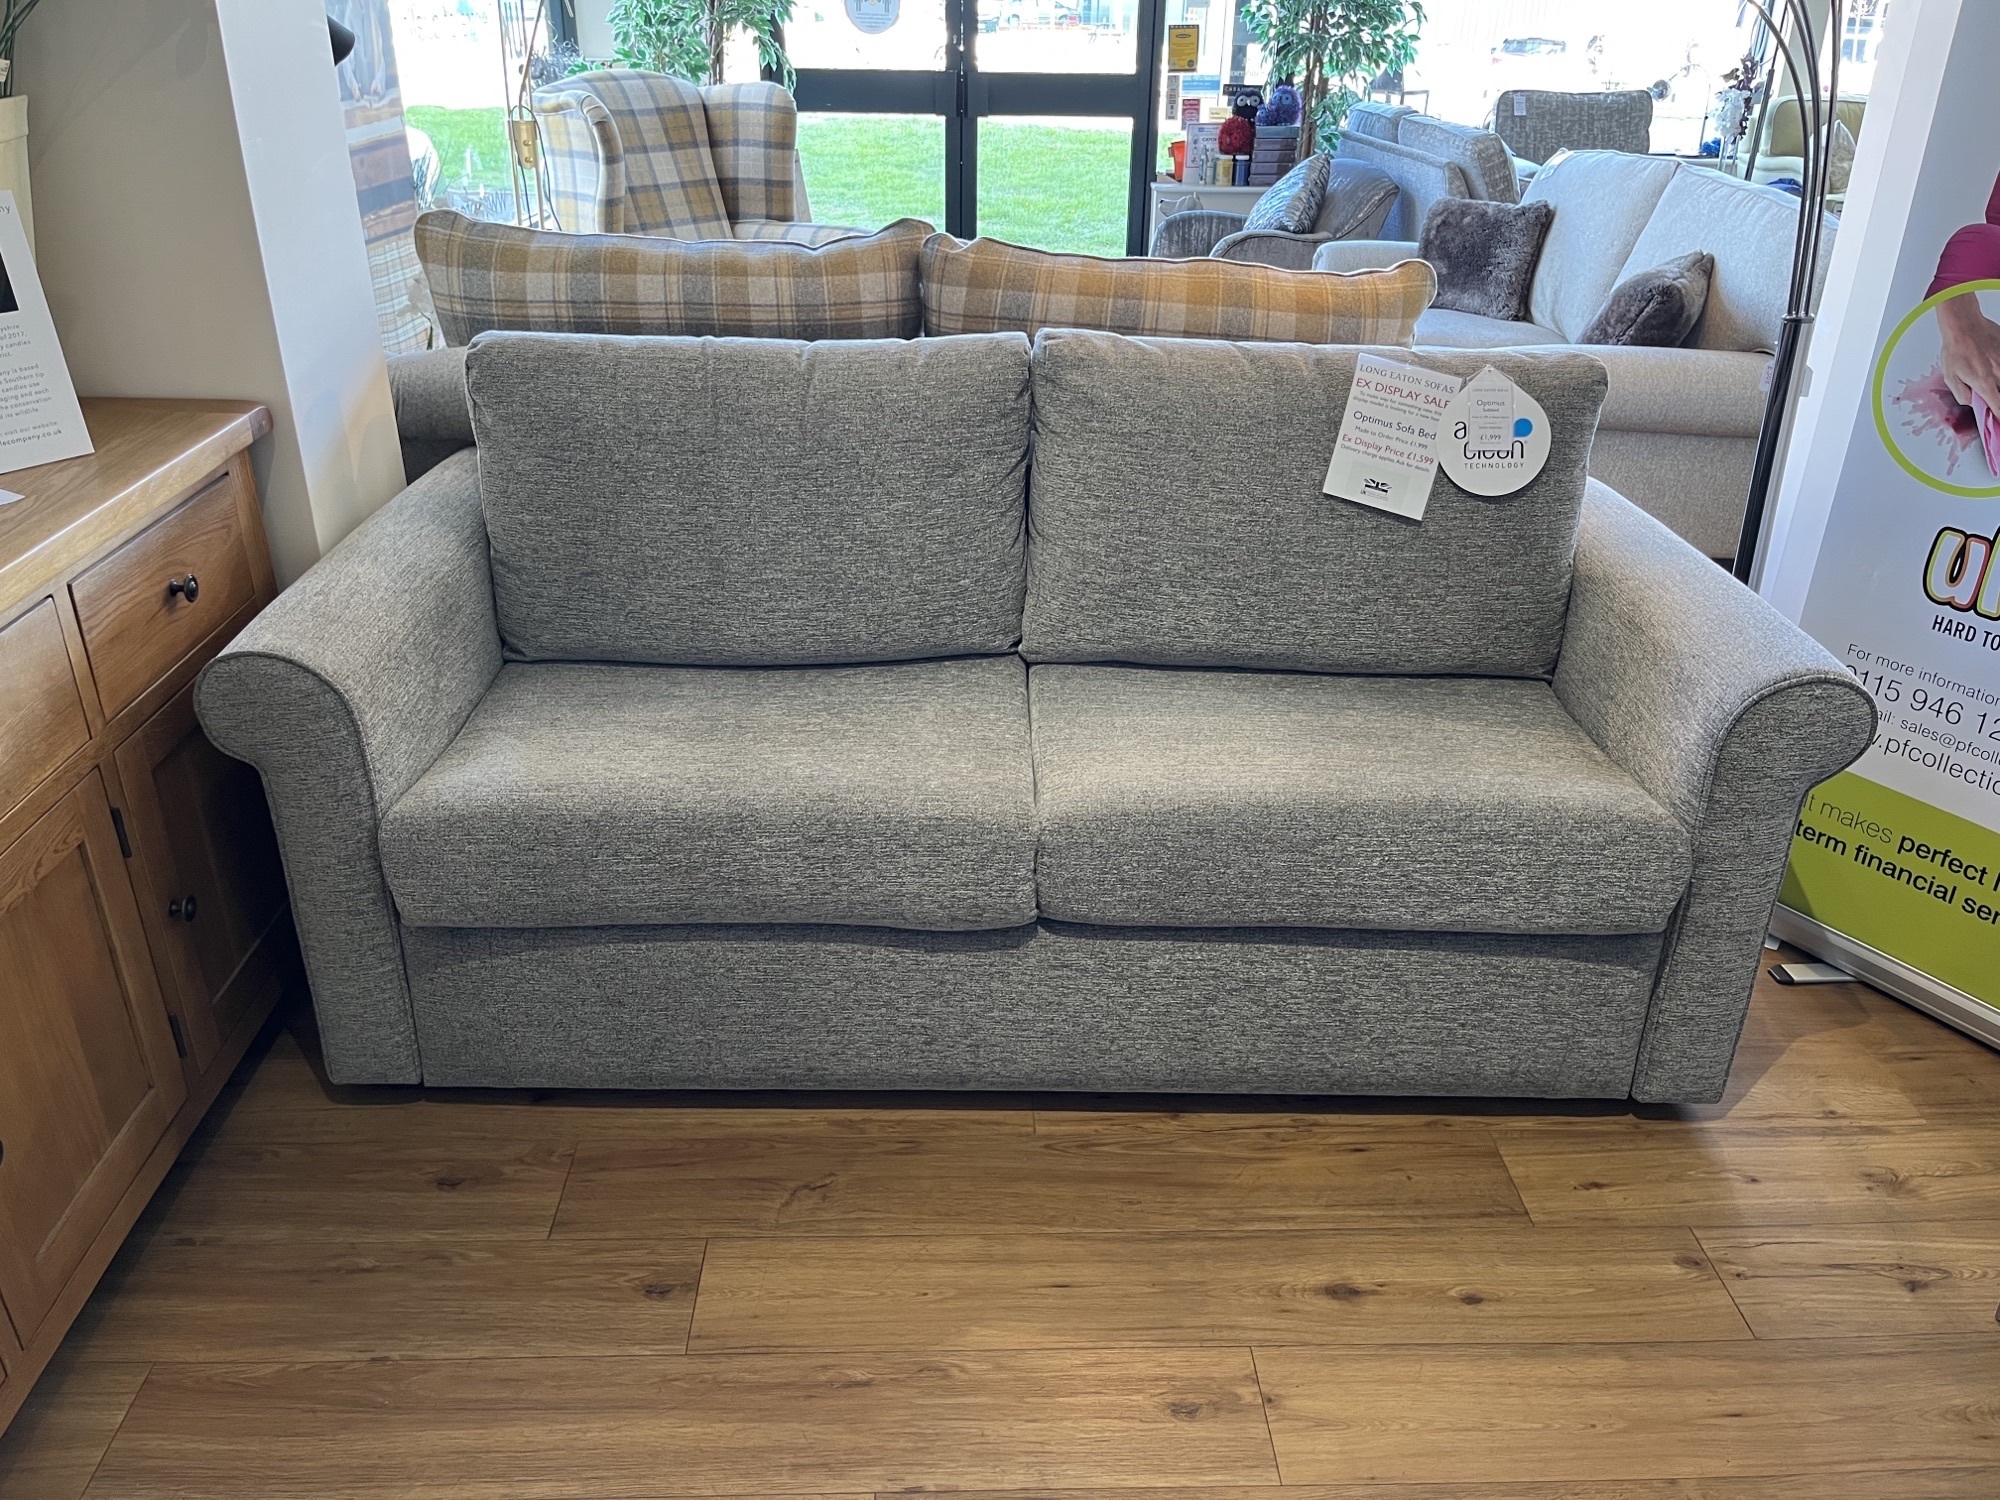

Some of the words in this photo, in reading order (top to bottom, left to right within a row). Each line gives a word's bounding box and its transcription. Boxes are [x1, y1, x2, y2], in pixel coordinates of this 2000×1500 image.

[1356, 378, 1372, 390] EX
[1374, 382, 1422, 401] DISPLAY
[1359, 364, 1388, 377] LONG
[1389, 371, 1422, 385] EATON
[1424, 380, 1455, 394] SOFAS
[1476, 399, 1505, 407] Optimus
[1353, 410, 1393, 429] Optimus
[1395, 422, 1415, 436] Sofa
[1418, 428, 1437, 440] Bed
[1342, 434, 1352, 443] Ex
[1354, 437, 1383, 453] Display
[1384, 445, 1405, 458] Price
[1463, 462, 1525, 470] TECHNOLOGY
[1931, 614, 1977, 643] HARD
[1982, 630, 2000, 651] TO
[1847, 643, 1872, 662] For
[1875, 655, 1915, 677] more
[1910, 688, 1964, 725] 946
[1819, 801, 1893, 844] makes
[1897, 835, 1988, 886] perfect
[1795, 818, 1847, 856] term
[1853, 844, 1957, 904] financial
